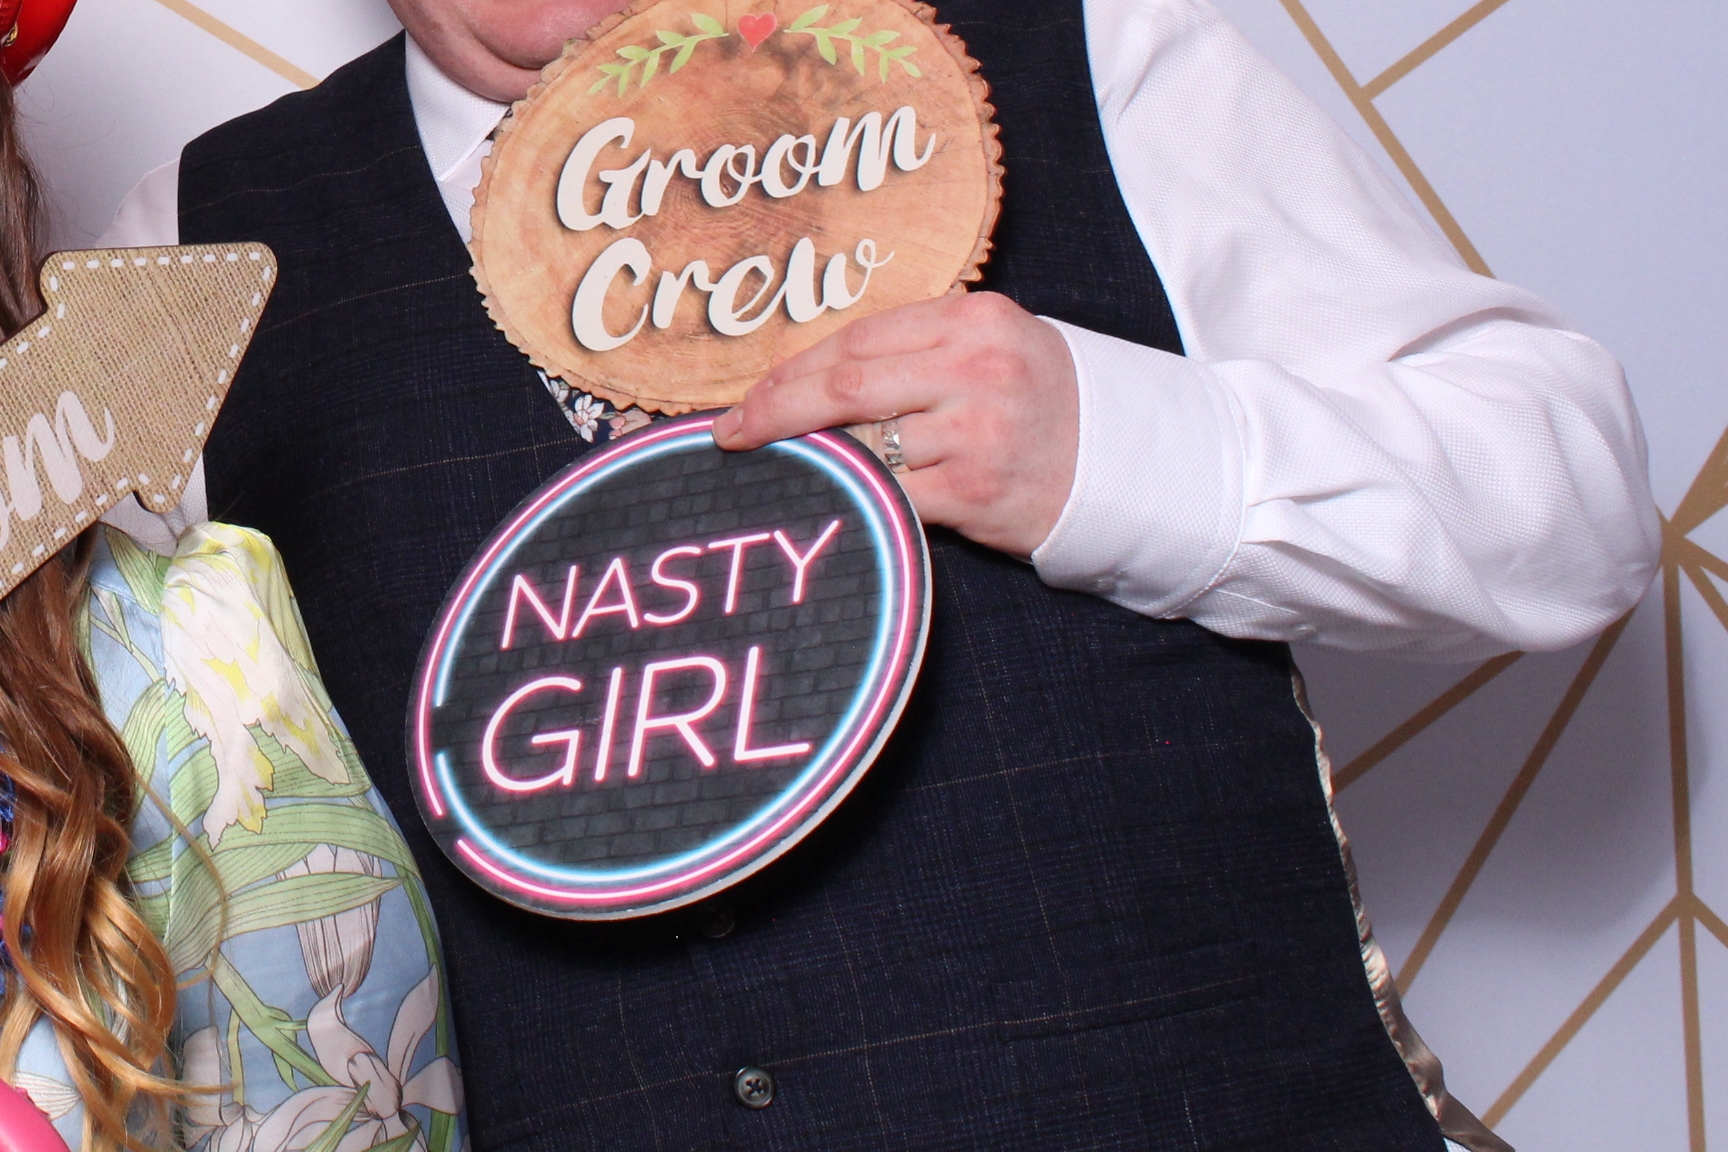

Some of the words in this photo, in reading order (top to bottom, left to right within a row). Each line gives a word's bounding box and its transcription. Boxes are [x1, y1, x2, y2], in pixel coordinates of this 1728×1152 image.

[555, 105, 937, 232] Groom
[571, 236, 895, 352] Crew
[500, 519, 841, 650] NASTY
[480, 645, 812, 792] GIRL
